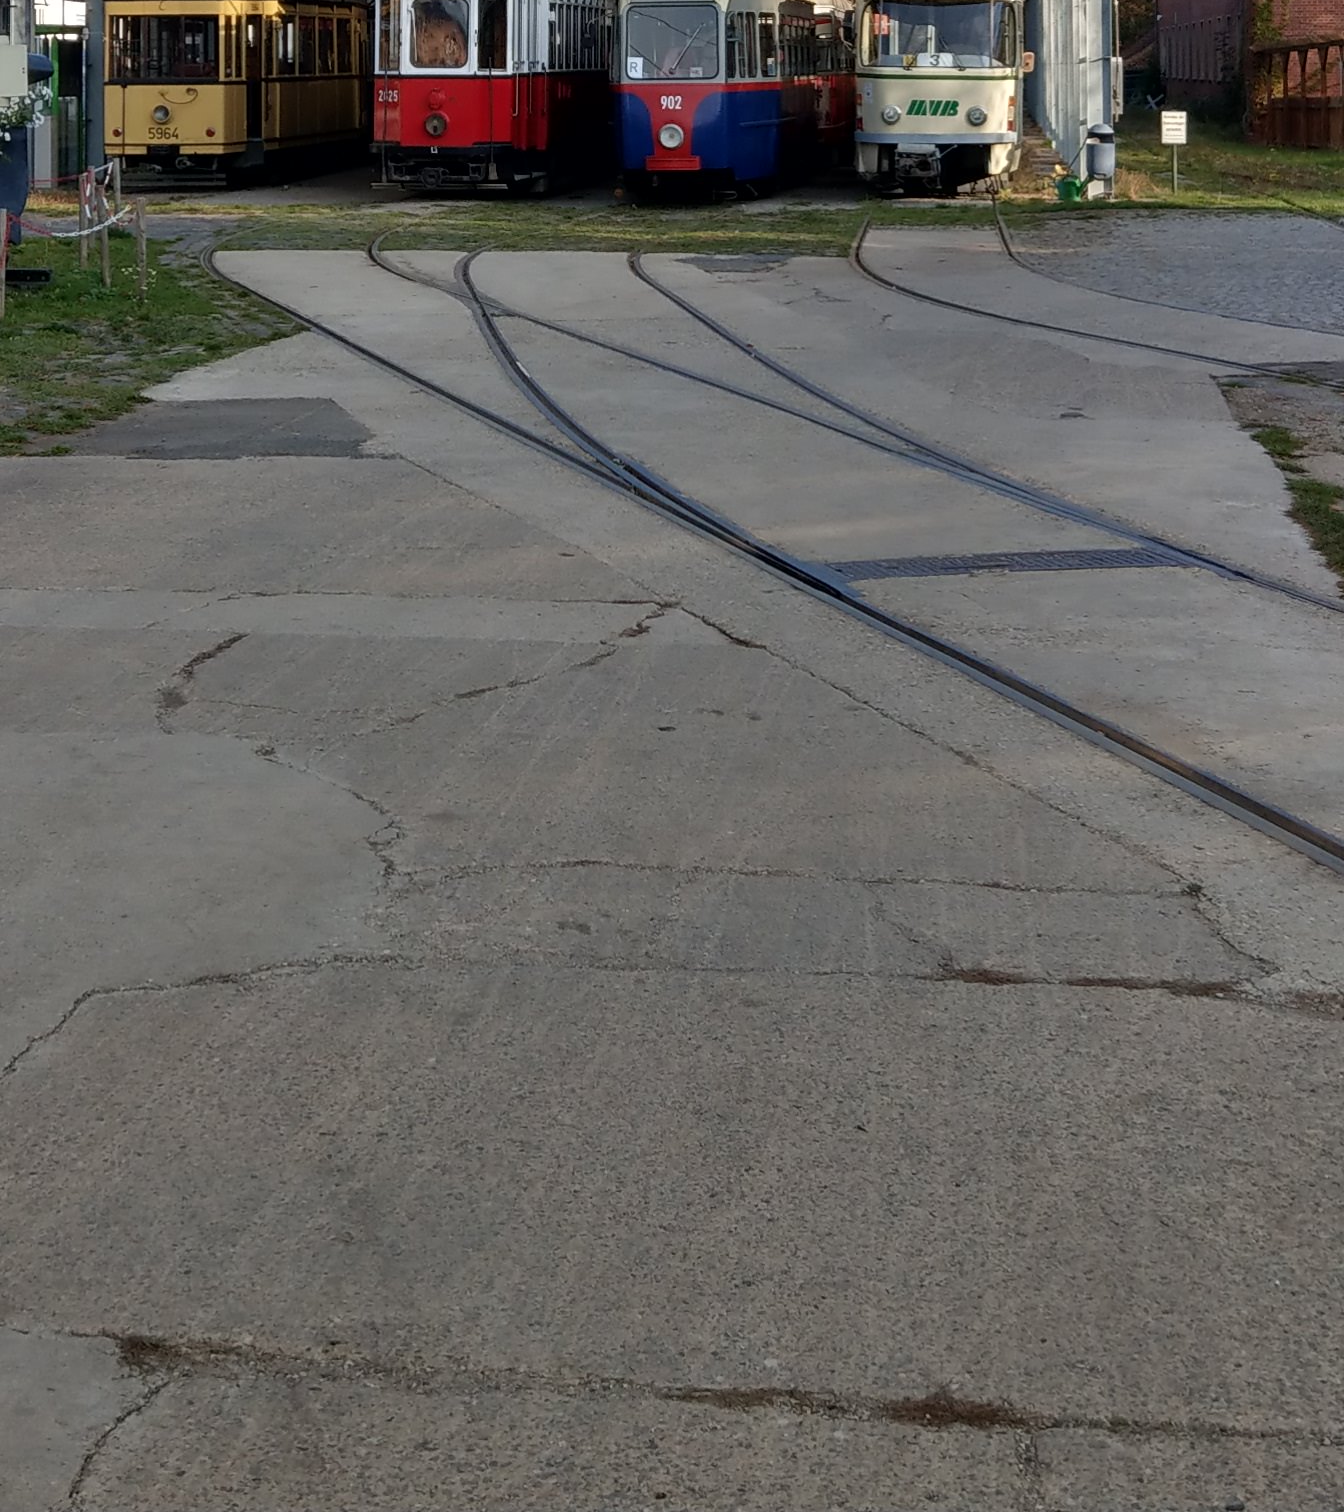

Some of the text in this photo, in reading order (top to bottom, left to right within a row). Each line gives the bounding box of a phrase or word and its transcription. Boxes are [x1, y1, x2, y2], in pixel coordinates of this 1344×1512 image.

[929, 54, 941, 66] 3
[629, 61, 638, 73] R
[660, 95, 682, 110] 902
[147, 127, 179, 140] 5964
